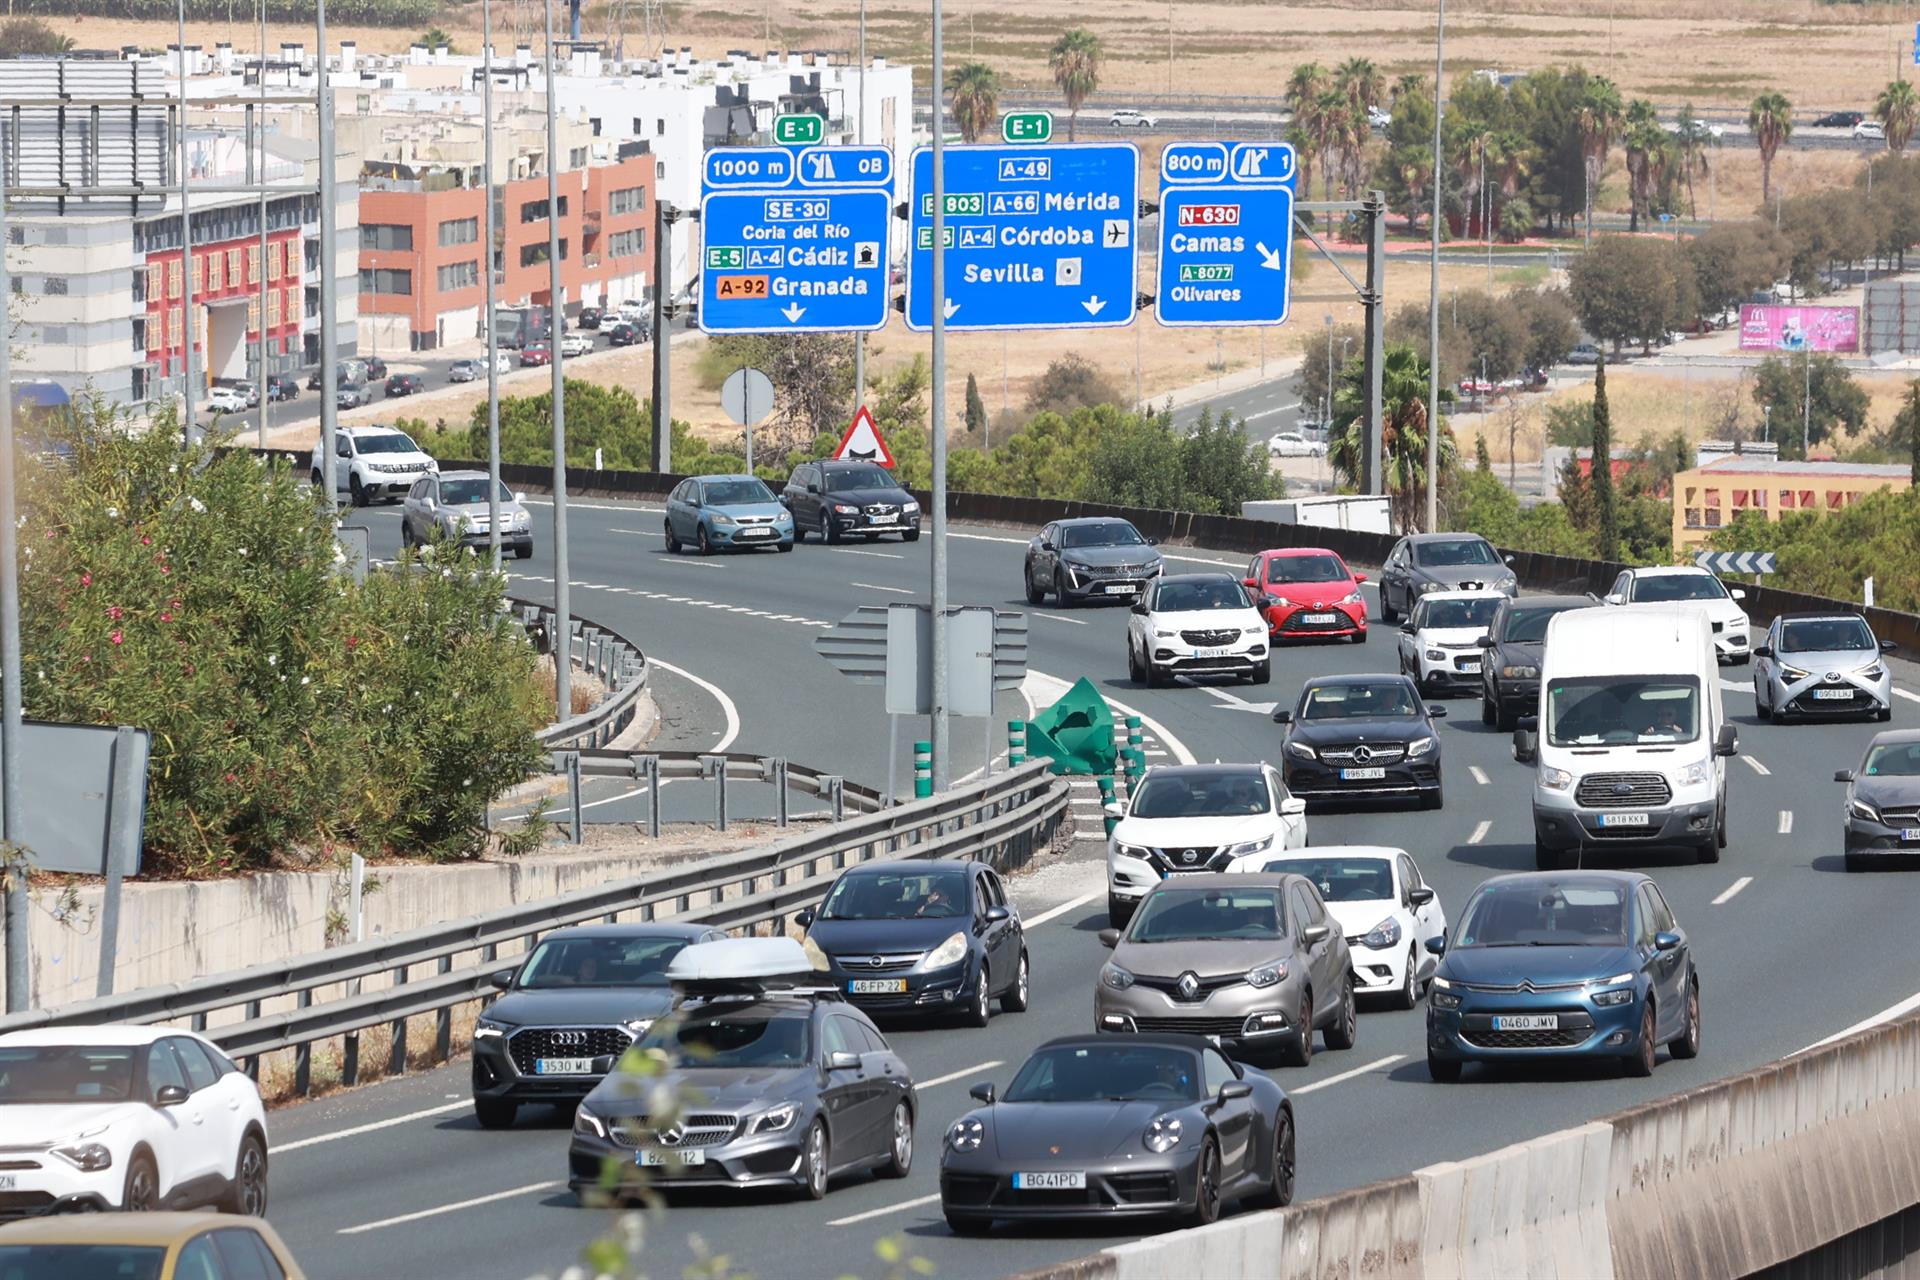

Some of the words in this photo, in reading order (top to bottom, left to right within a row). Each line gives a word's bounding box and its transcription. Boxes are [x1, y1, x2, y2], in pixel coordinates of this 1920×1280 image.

[784, 121, 814, 138] E-1
[1012, 119, 1043, 136] E-1
[713, 160, 760, 176] 1000
[768, 161, 784, 175] m
[1002, 161, 1048, 177] A-49
[1168, 154, 1203, 171] 800
[1207, 158, 1222, 171] m
[1281, 155, 1289, 170] 1
[767, 202, 826, 218] SE-30
[993, 196, 1036, 212] A-66
[1045, 192, 1121, 212] Mérida
[1181, 208, 1237, 224] N-630
[742, 225, 786, 240] Coria
[793, 224, 818, 240] del
[825, 223, 850, 239] Río
[962, 229, 993, 245] A-4
[1001, 226, 1094, 246] Córdoba
[1170, 233, 1245, 253] Camas
[709, 250, 741, 266] E-5
[750, 250, 781, 266] A-4
[788, 246, 848, 267] Cádiz
[963, 263, 1045, 284] Sevilla
[1182, 267, 1232, 280] A-8077
[720, 279, 765, 295] A-92
[772, 276, 868, 296] Granada
[1171, 286, 1242, 302] Olivares
[1500, 1016, 1530, 1028] 0460
[1533, 1016, 1555, 1028] JMV
[543, 1060, 571, 1072] 3530
[575, 1060, 590, 1072] ML
